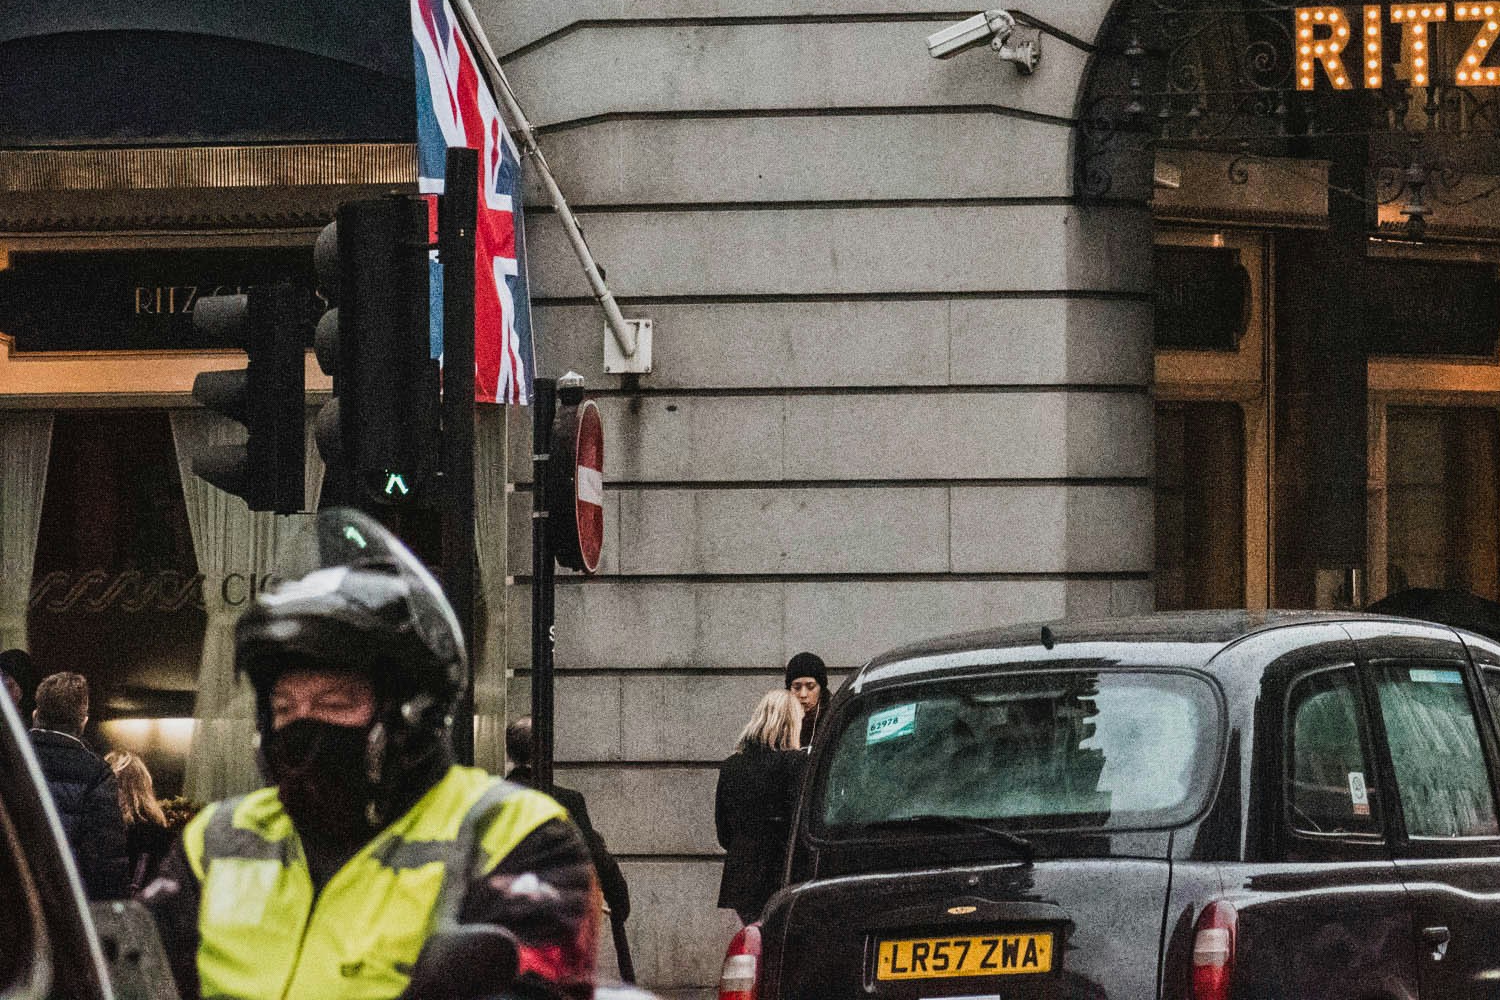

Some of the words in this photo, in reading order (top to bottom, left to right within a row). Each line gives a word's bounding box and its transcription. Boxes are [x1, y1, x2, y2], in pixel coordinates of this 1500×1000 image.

[135, 286, 198, 313] RITZ
[891, 940, 971, 973] LR57
[980, 938, 1038, 969] ZWA
